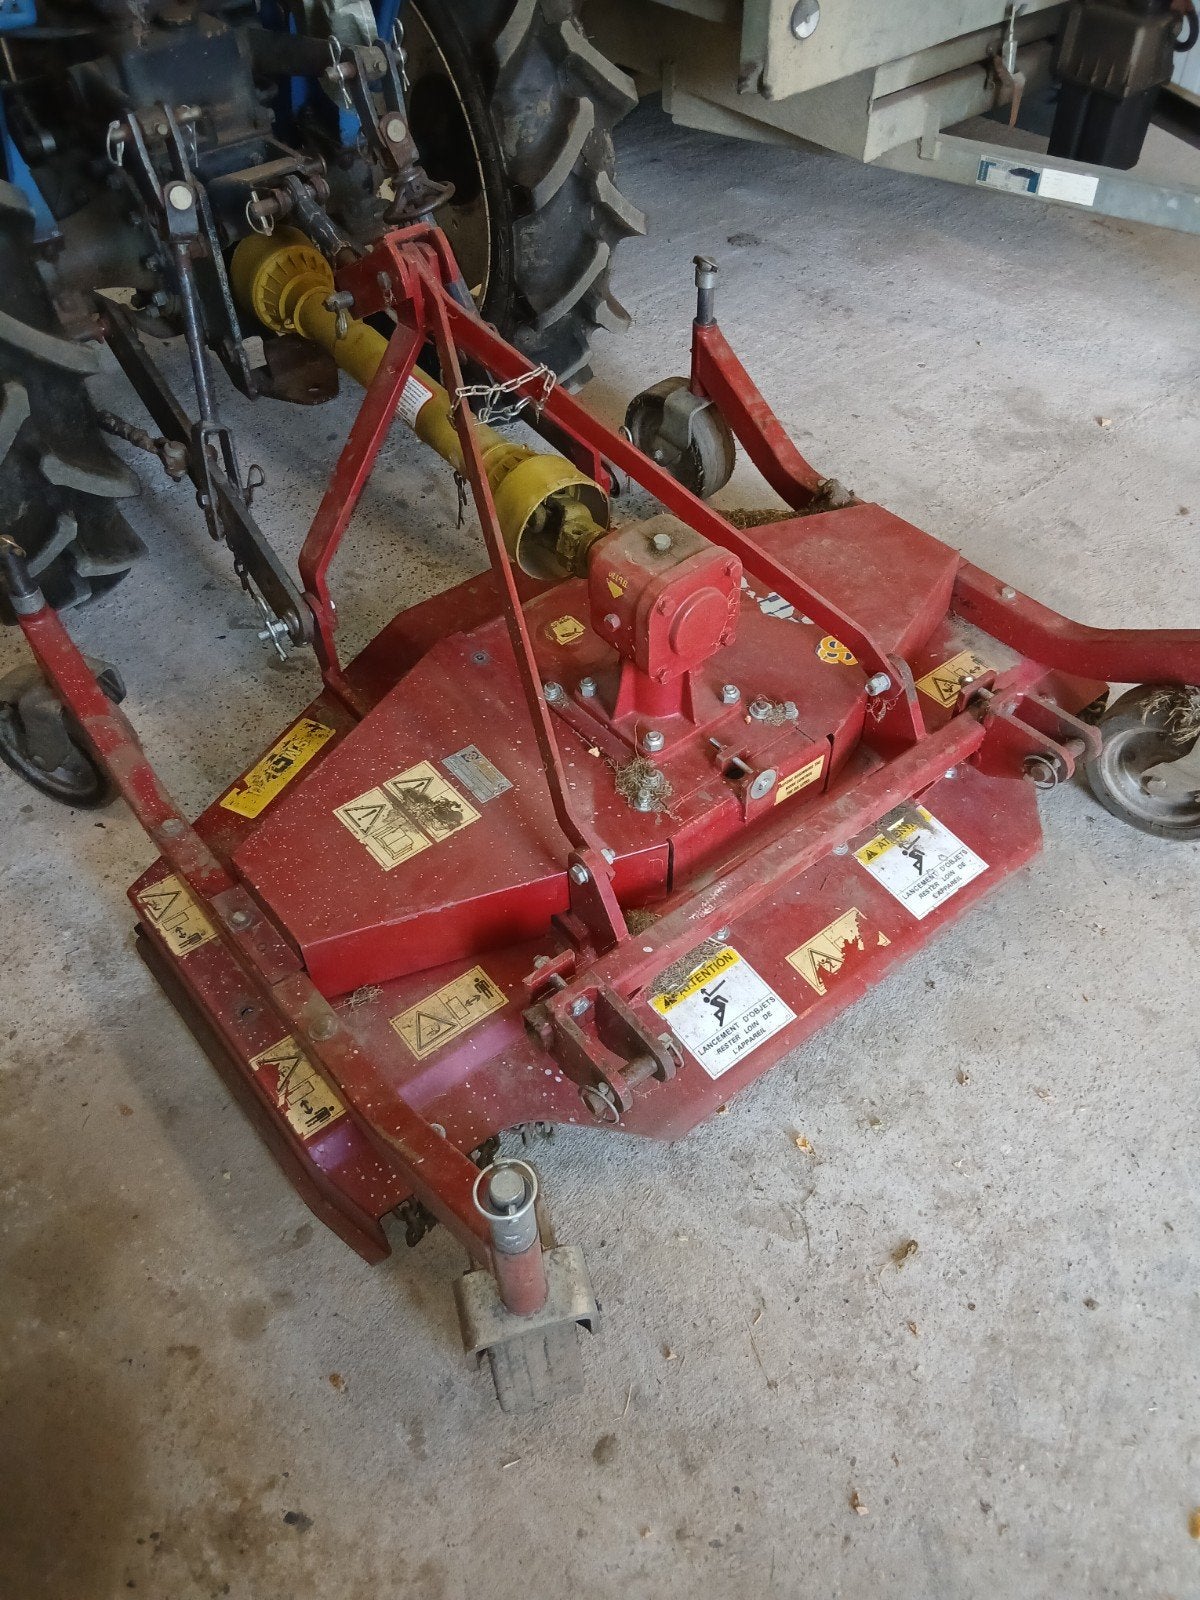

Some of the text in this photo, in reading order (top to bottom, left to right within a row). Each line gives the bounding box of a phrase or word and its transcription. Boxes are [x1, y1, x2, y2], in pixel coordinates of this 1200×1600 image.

[901, 849, 968, 900] LANCEMENT D'OBJETS
[918, 861, 966, 899] RESTER LOIN DE
[697, 996, 776, 1056] LANCEMENT D'OBJETS
[716, 1010, 773, 1055] RESTER LOIN DE
[732, 1027, 767, 1056] L'APPAREIL
